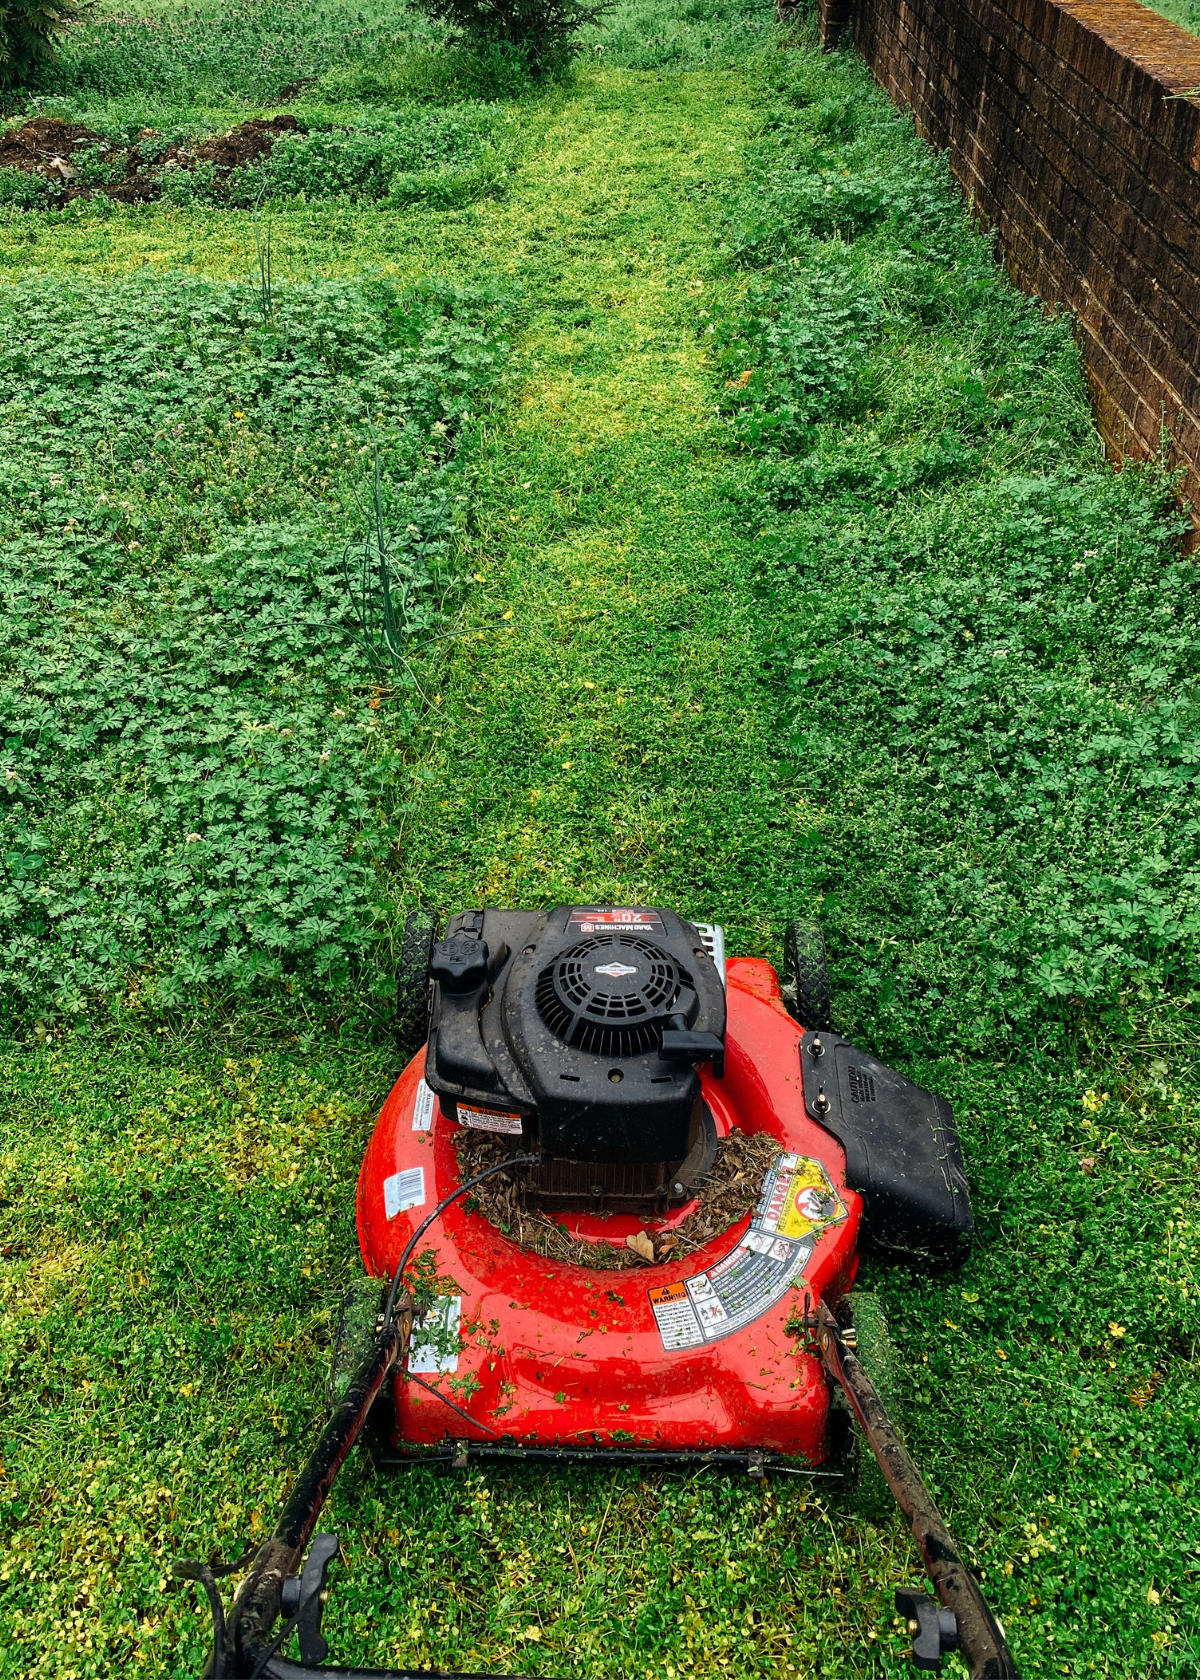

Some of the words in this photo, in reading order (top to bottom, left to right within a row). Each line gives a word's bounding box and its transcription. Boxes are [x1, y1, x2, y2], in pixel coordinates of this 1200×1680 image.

[848, 1066, 859, 1103] CAUTION
[767, 1165, 793, 1221] DANGER
[777, 1216, 786, 1231] KEEP
[782, 1198, 792, 1216] HANDS
[791, 1176, 799, 1188] FEET
[715, 1249, 744, 1272] DANGER
[652, 1292, 686, 1304] WARNING
